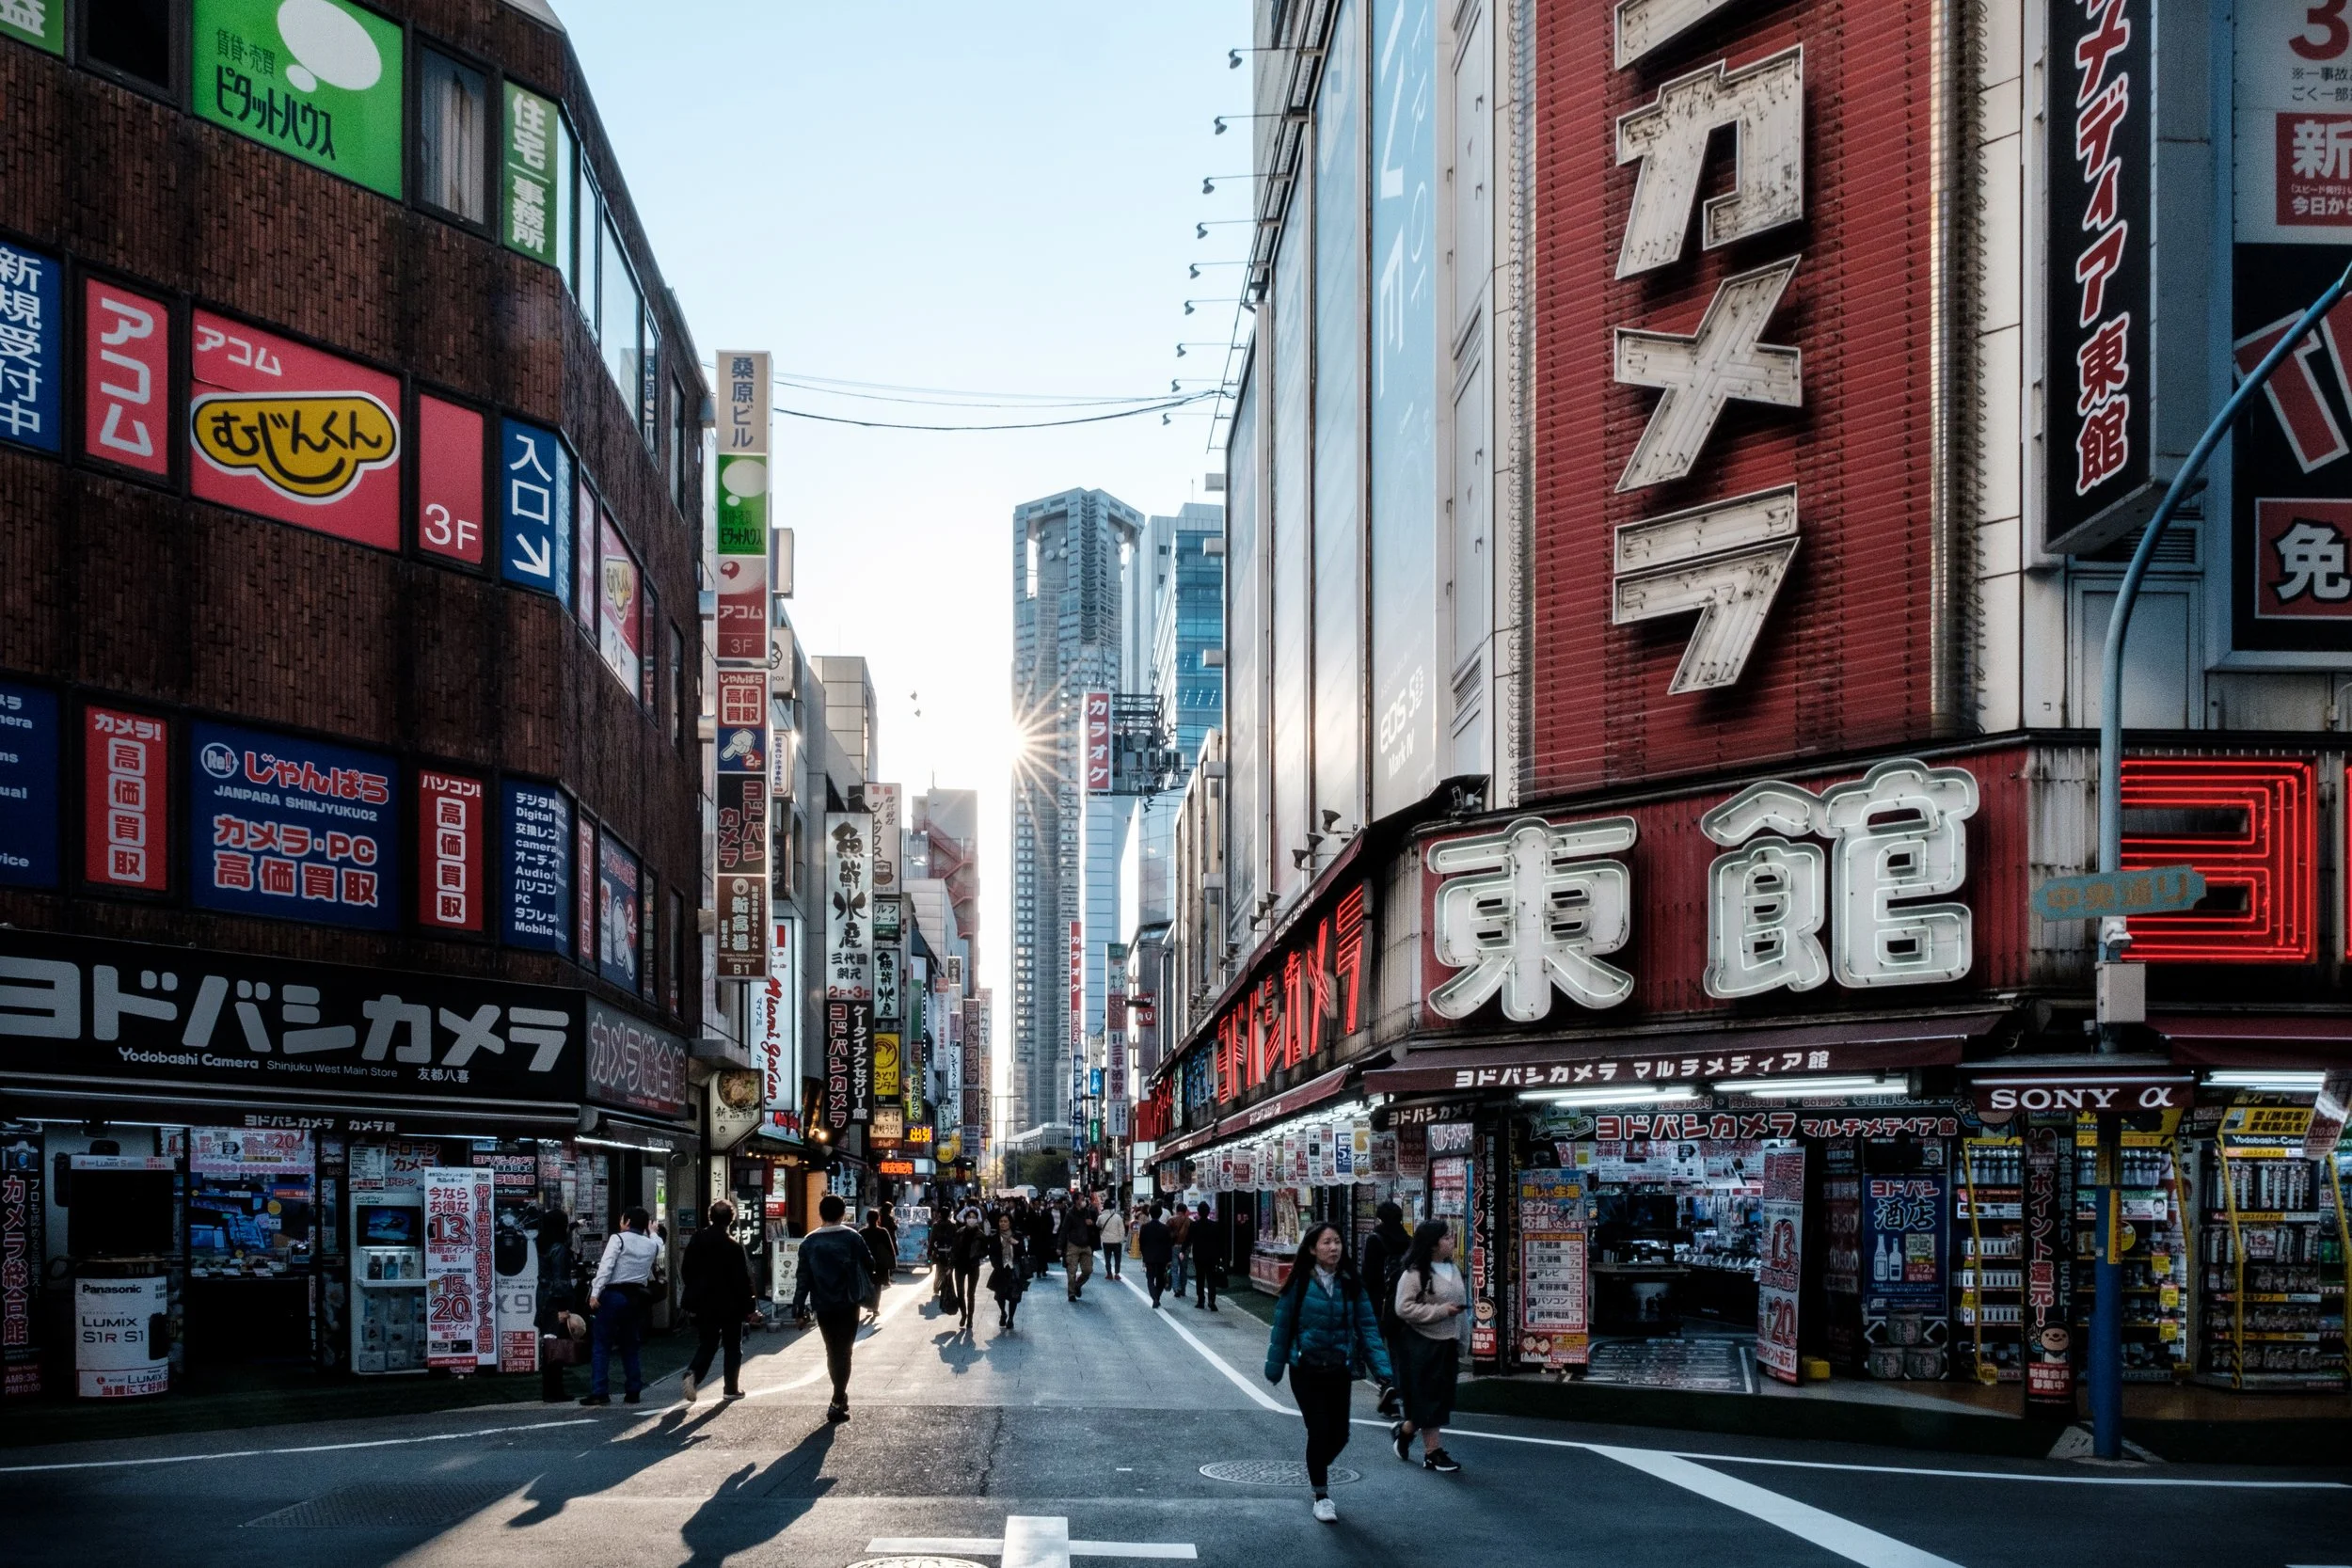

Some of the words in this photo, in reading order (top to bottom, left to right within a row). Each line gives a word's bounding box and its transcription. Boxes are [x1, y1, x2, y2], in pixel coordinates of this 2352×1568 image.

[216, 27, 275, 78] 賃貸・売買
[215, 64, 336, 161] ピタットハウス
[2291, 119, 2352, 180] 新
[0, 246, 42, 436] 新規受付中
[197, 325, 282, 376] アコム
[1613, 0, 1804, 697] カメラ
[100, 297, 154, 457] アコム
[731, 356, 755, 449] 桑原ビル
[210, 409, 383, 484] むじんくん
[509, 435, 553, 525] 入口
[425, 503, 479, 550] 3F
[721, 527, 763, 546] ピタットハウス
[2276, 521, 2352, 604] 免
[719, 605, 764, 619] アコム
[730, 638, 754, 654] 3F
[719, 673, 764, 685] じゃんぱら
[725, 689, 758, 705] 高価
[725, 705, 758, 722] 買取
[94, 713, 161, 741] カメラ!
[1380, 688, 1406, 754] EOS
[1089, 700, 1107, 783] カラオケ
[745, 753, 762, 768] 2F
[1389, 739, 1406, 781] Mark
[245, 752, 389, 805] じゃんぱら
[421, 775, 481, 798] パソコン!
[110, 741, 144, 879] 高価買取
[215, 785, 280, 806] JANPARA
[285, 797, 378, 821] SHINJYUKU02
[516, 806, 552, 821] Digital
[719, 807, 740, 868] カメラ
[742, 780, 765, 863] ヨドバシ
[437, 799, 465, 922] 高価買取
[214, 850, 378, 907] 高価買取
[516, 879, 557, 895] パソコン
[831, 820, 868, 950] 魚鮮水産
[1428, 758, 1979, 1022] 東館
[2047, 873, 2188, 911] 中央通り
[515, 893, 532, 904] PC
[515, 921, 553, 936] Mobile
[831, 952, 868, 966] 三代目
[1217, 883, 1364, 1104] ヨドバシカメラ
[0, 956, 569, 1072] ヨドバシカメラ
[964, 1000, 979, 1084] ヨドバシカメラ
[118, 1047, 198, 1066] Yodobashi
[201, 1053, 259, 1069] Camera
[267, 1060, 312, 1074] Shinjuku
[314, 1062, 341, 1074] West
[342, 1065, 368, 1076] Main
[371, 1067, 398, 1079] Store
[417, 1068, 470, 1084] 友都八喜
[828, 1003, 848, 1129] ヨドバシカメラ
[852, 1005, 868, 1120] ケータイアクセサリー館
[1455, 1060, 1619, 1087] ヨドバシカメラ
[1633, 1050, 1831, 1080] マルチメディア館
[1389, 1101, 1477, 1126] ヨドバシカメラ
[1991, 1088, 2120, 1110] SONY
[2138, 1086, 2174, 1108] α
[245, 1114, 335, 1129] ヨドバシカメラ
[348, 1119, 396, 1132] カメラ館
[1595, 1112, 1797, 1142] ヨドバシカメラ
[1801, 1116, 1959, 1137] マルチメディア館
[473, 1156, 535, 1165] ヨドバシカメラ
[429, 1187, 469, 1200] 今なら
[1521, 1184, 1581, 1199] 新しい生活
[1869, 1180, 1941, 1198] ヨドバシ
[429, 1200, 470, 1213] お得な
[1521, 1200, 1558, 1215] 全力で
[1521, 1214, 1584, 1229] 応援いたします
[1872, 1197, 1936, 1231] 酒店
[430, 1214, 473, 1245] 13%
[2, 1174, 29, 1347] カメラ総合館
[82, 1284, 142, 1294] Panasonic
[82, 1317, 137, 1327] LUMIX
[430, 1294, 474, 1323] 20%
[83, 1331, 118, 1343] S1R
[124, 1331, 144, 1343] S1
[128, 1373, 162, 1384] LUMIX
